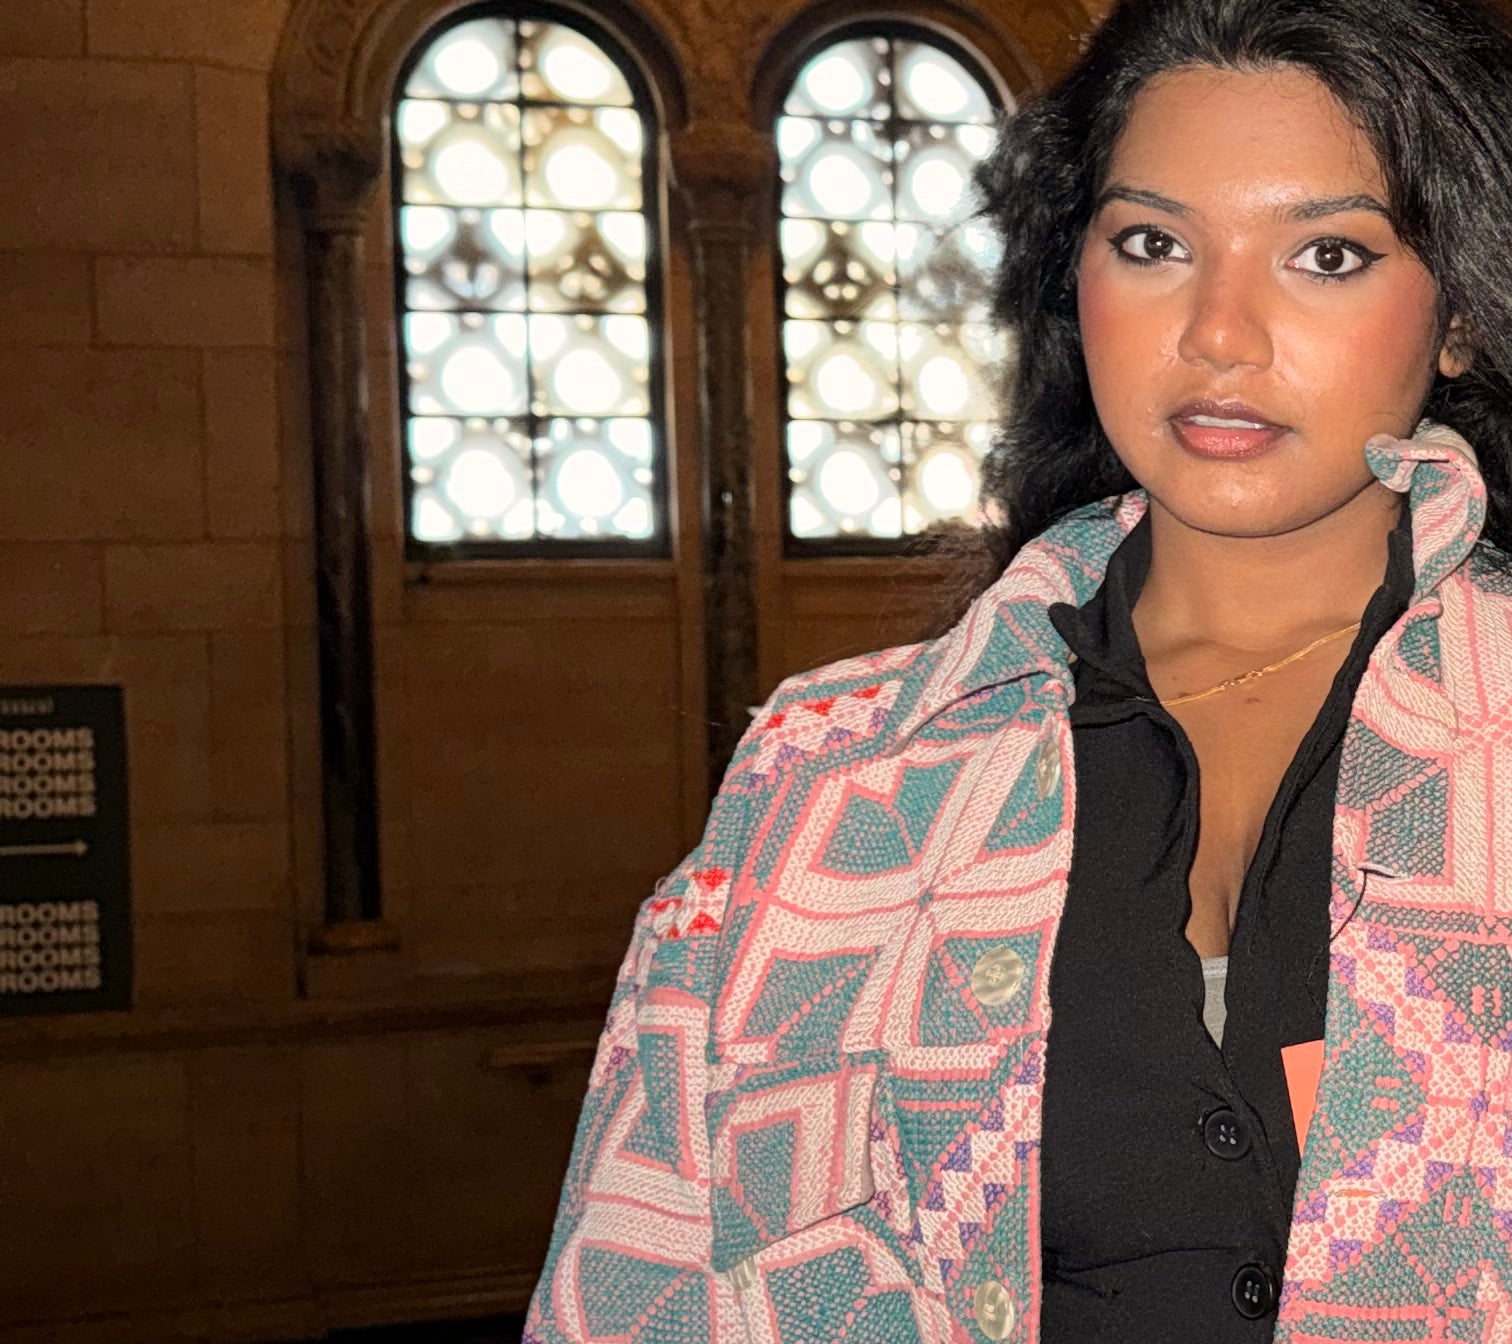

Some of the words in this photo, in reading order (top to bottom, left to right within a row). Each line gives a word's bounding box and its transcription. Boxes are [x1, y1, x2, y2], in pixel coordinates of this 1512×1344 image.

[0, 900, 99, 925] ROOMS
[0, 923, 100, 948] ROOMS
[0, 945, 101, 969] ROOMS
[0, 967, 102, 993] ROOMS
